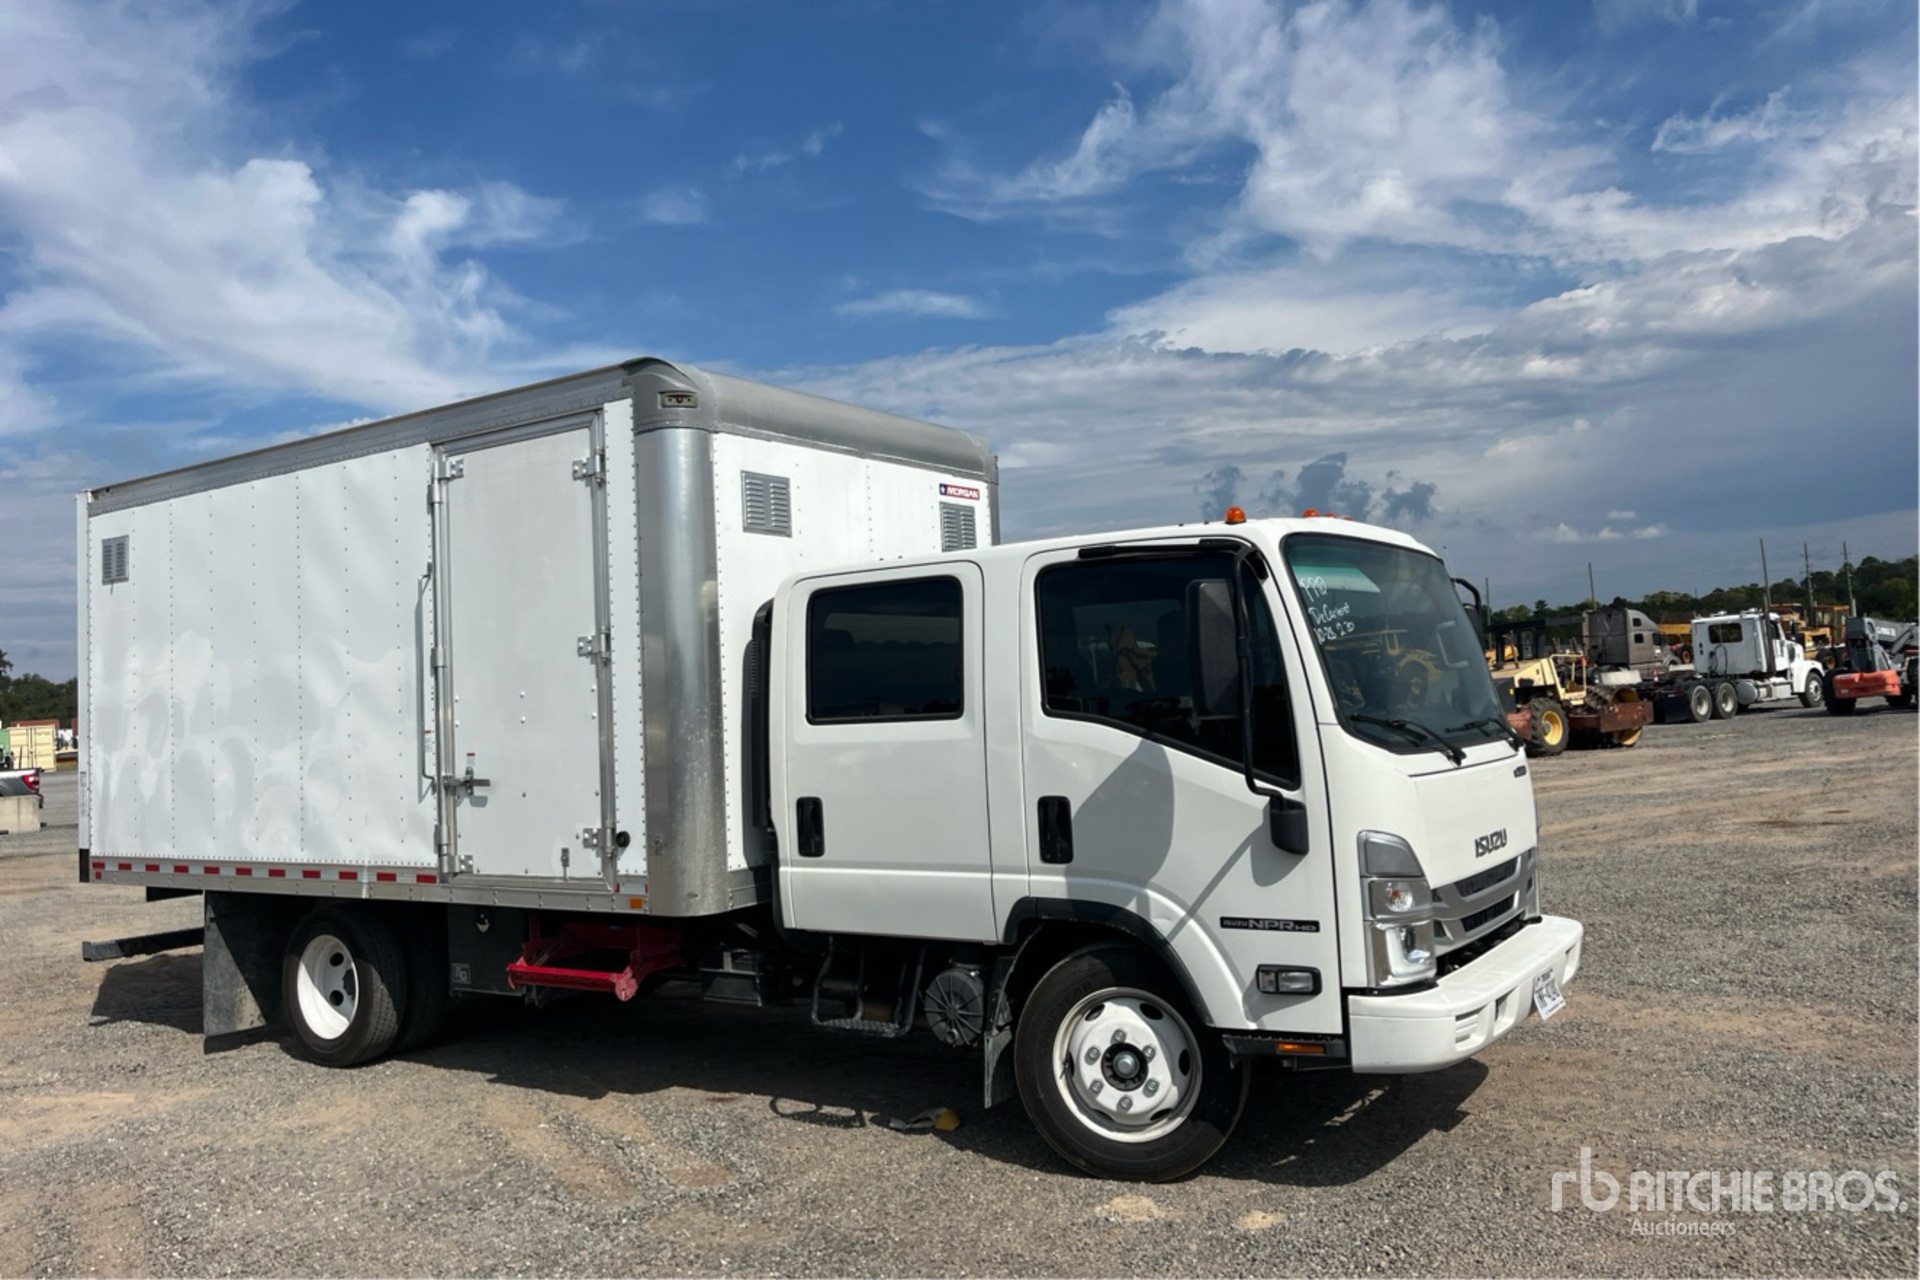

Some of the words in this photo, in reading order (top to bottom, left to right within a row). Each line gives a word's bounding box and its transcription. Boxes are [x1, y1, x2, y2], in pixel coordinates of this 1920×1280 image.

[947, 486, 979, 499] MORGAN
[1474, 828, 1508, 858] ISUZU
[1223, 919, 1248, 927] ISUZU
